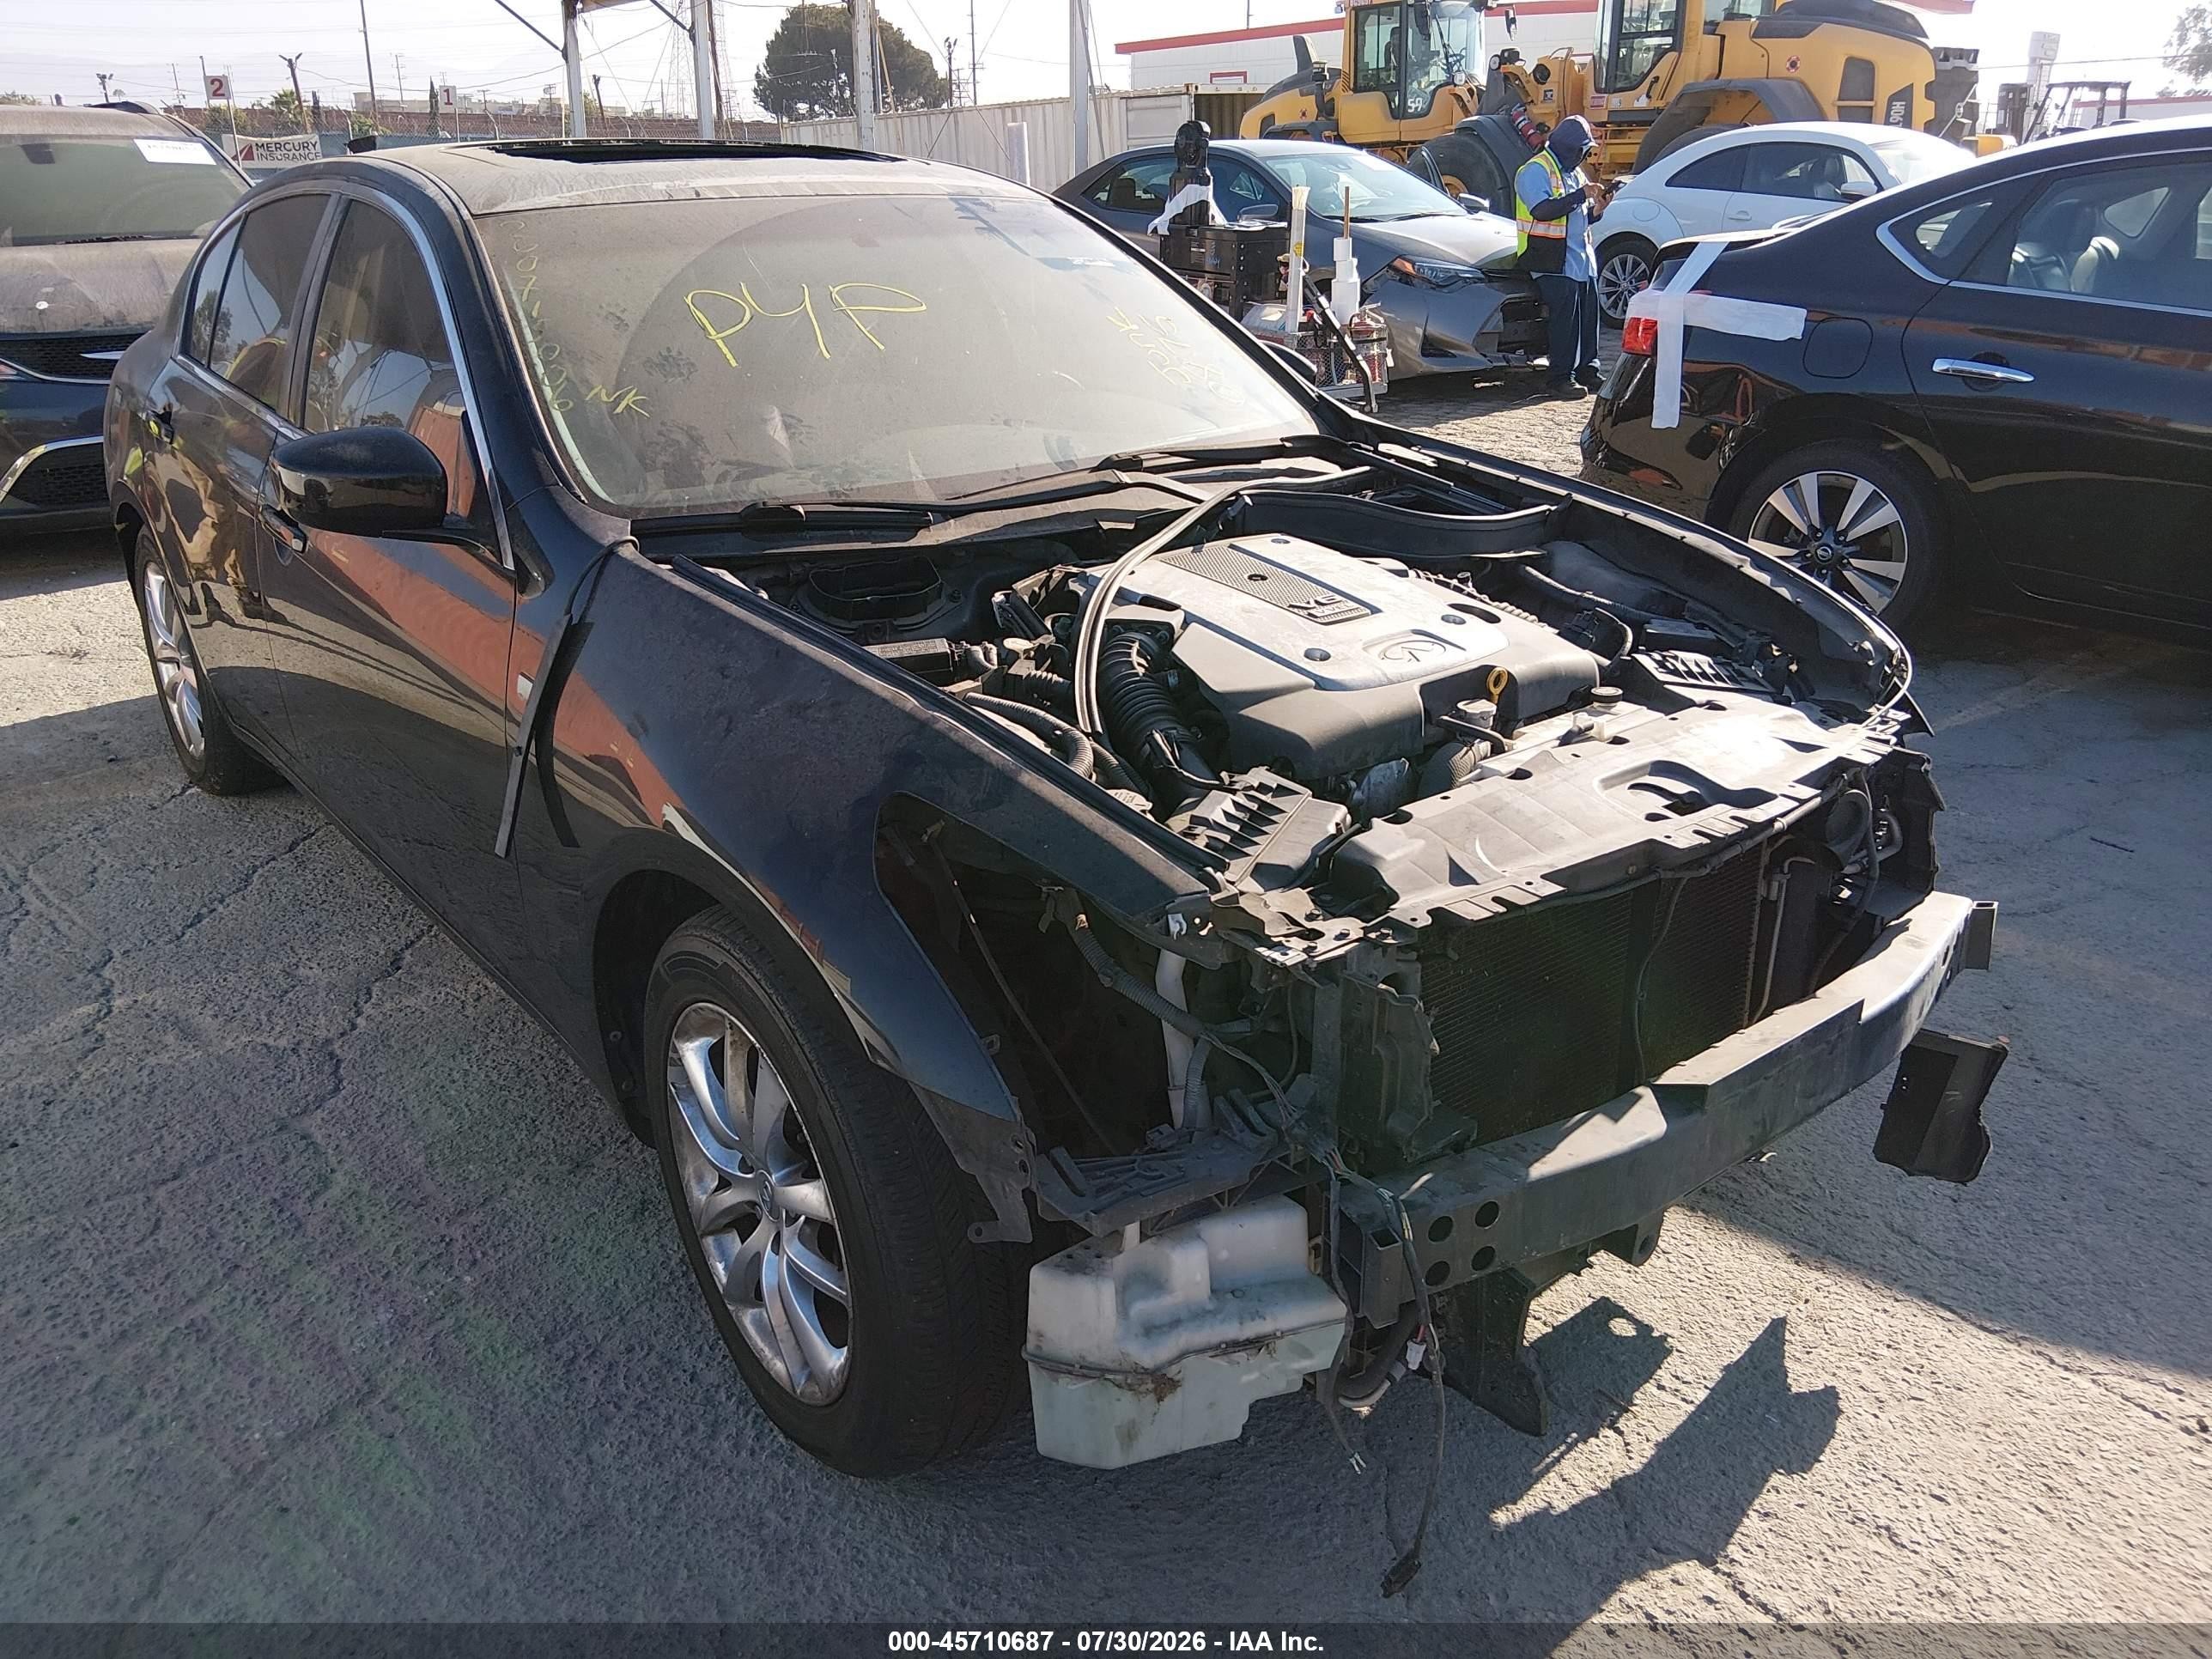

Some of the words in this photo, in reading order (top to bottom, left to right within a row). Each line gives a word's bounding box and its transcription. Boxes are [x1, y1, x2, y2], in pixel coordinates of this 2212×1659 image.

[210, 78, 225, 97] 2
[443, 88, 453, 105] 1
[255, 141, 317, 153] MERCURY
[257, 151, 321, 161] INSURANCE
